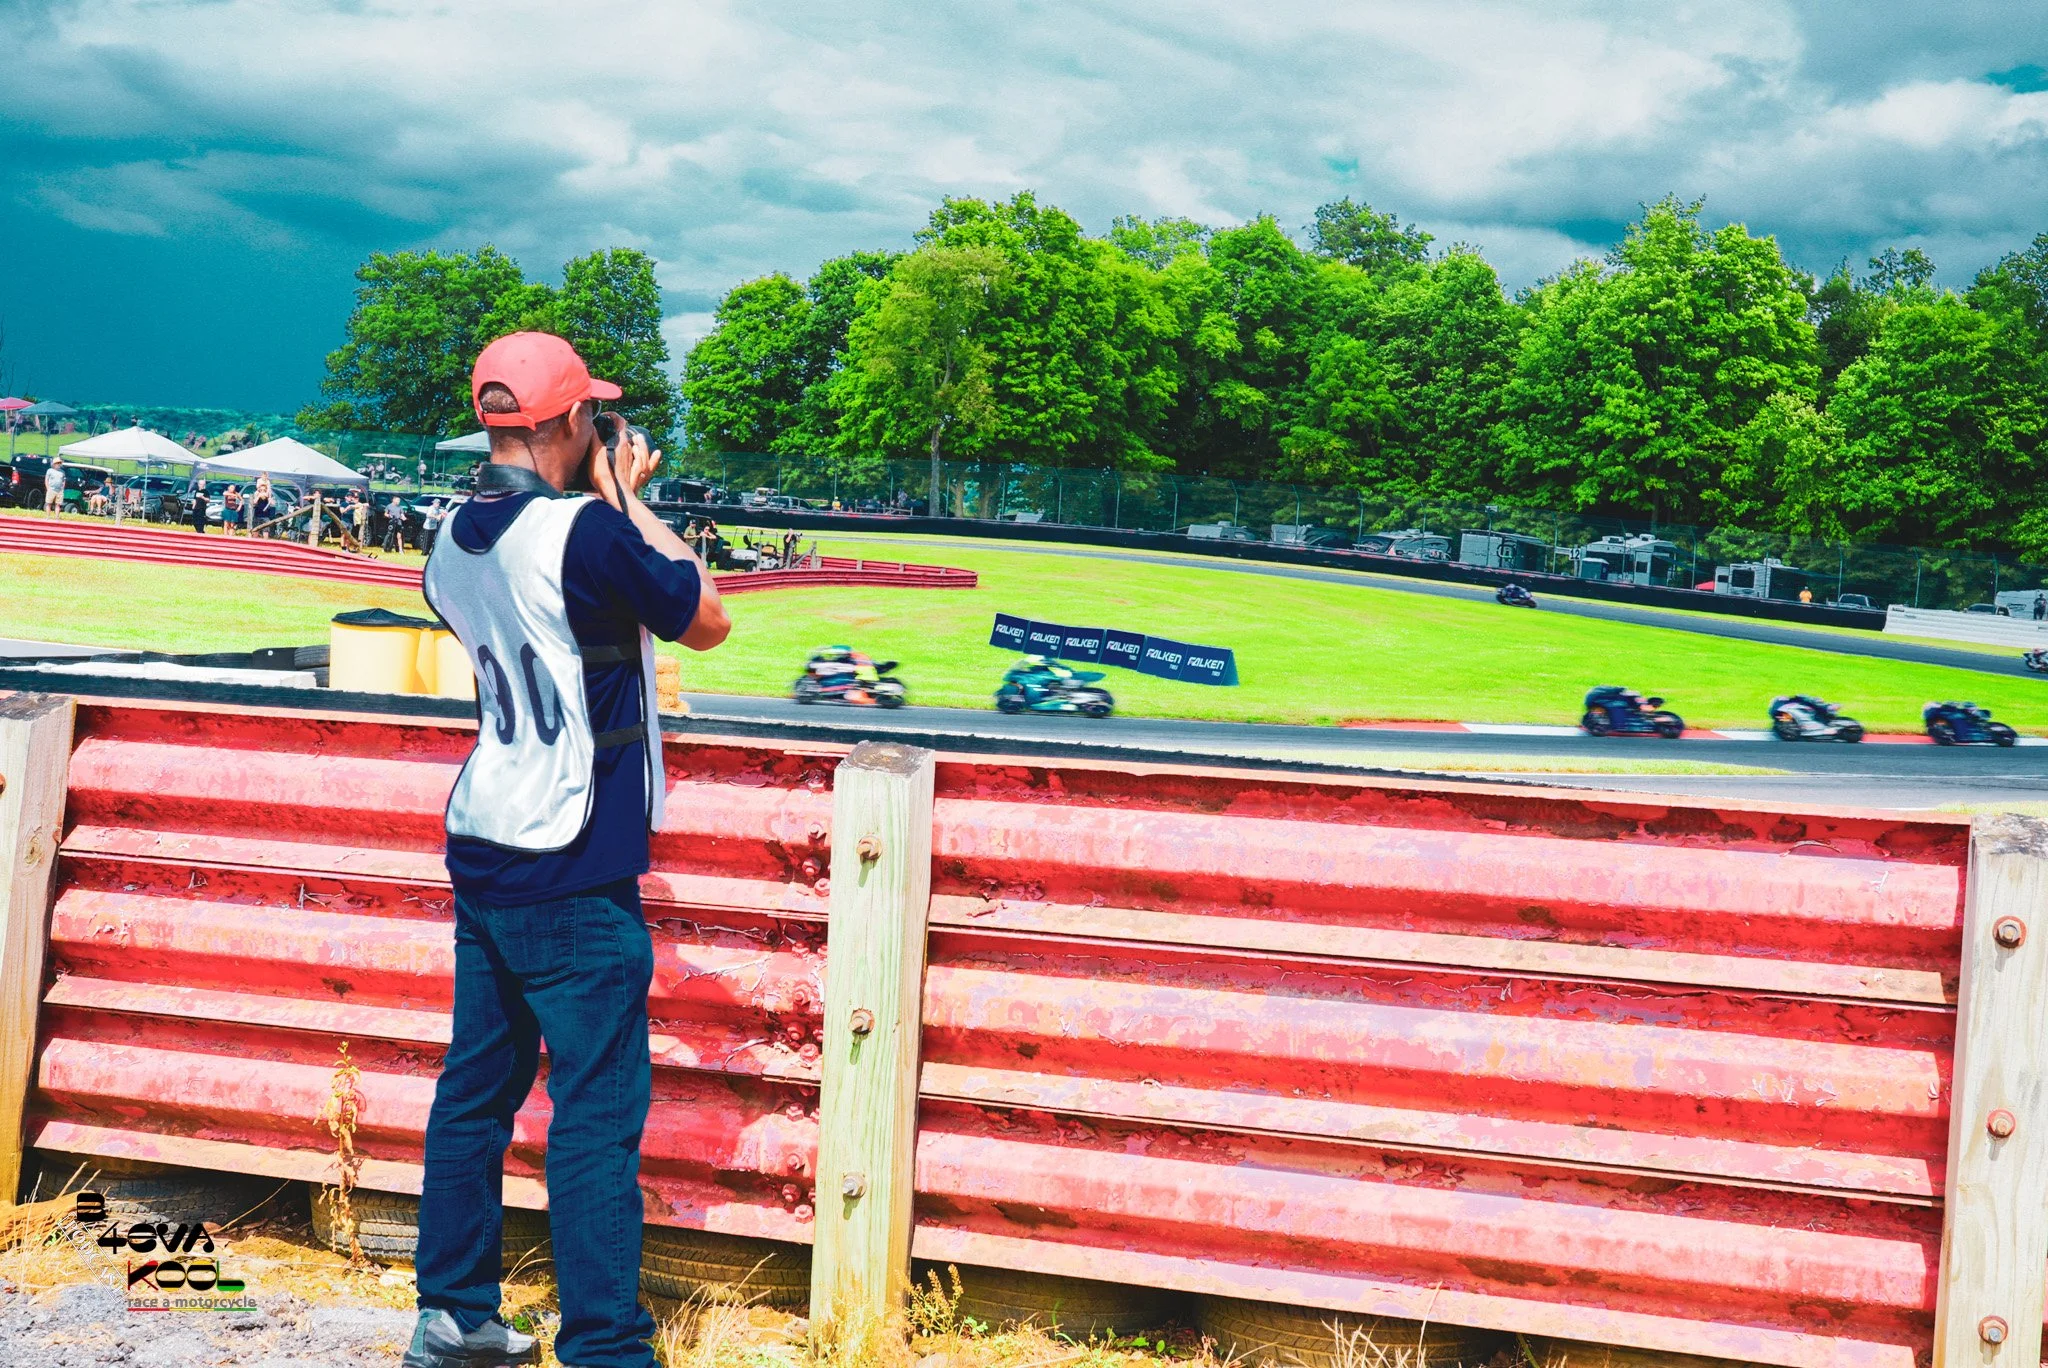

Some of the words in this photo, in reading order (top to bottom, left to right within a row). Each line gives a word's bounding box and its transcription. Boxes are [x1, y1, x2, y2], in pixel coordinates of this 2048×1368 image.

[1570, 549, 1580, 559] 12
[995, 624, 1024, 638] FALKEN
[1030, 632, 1060, 645] FALKEN
[1065, 637, 1099, 649] FALKEN
[1106, 640, 1140, 654] FALKEN
[1146, 648, 1182, 664] FALKEN
[1187, 656, 1225, 670] FALKEN
